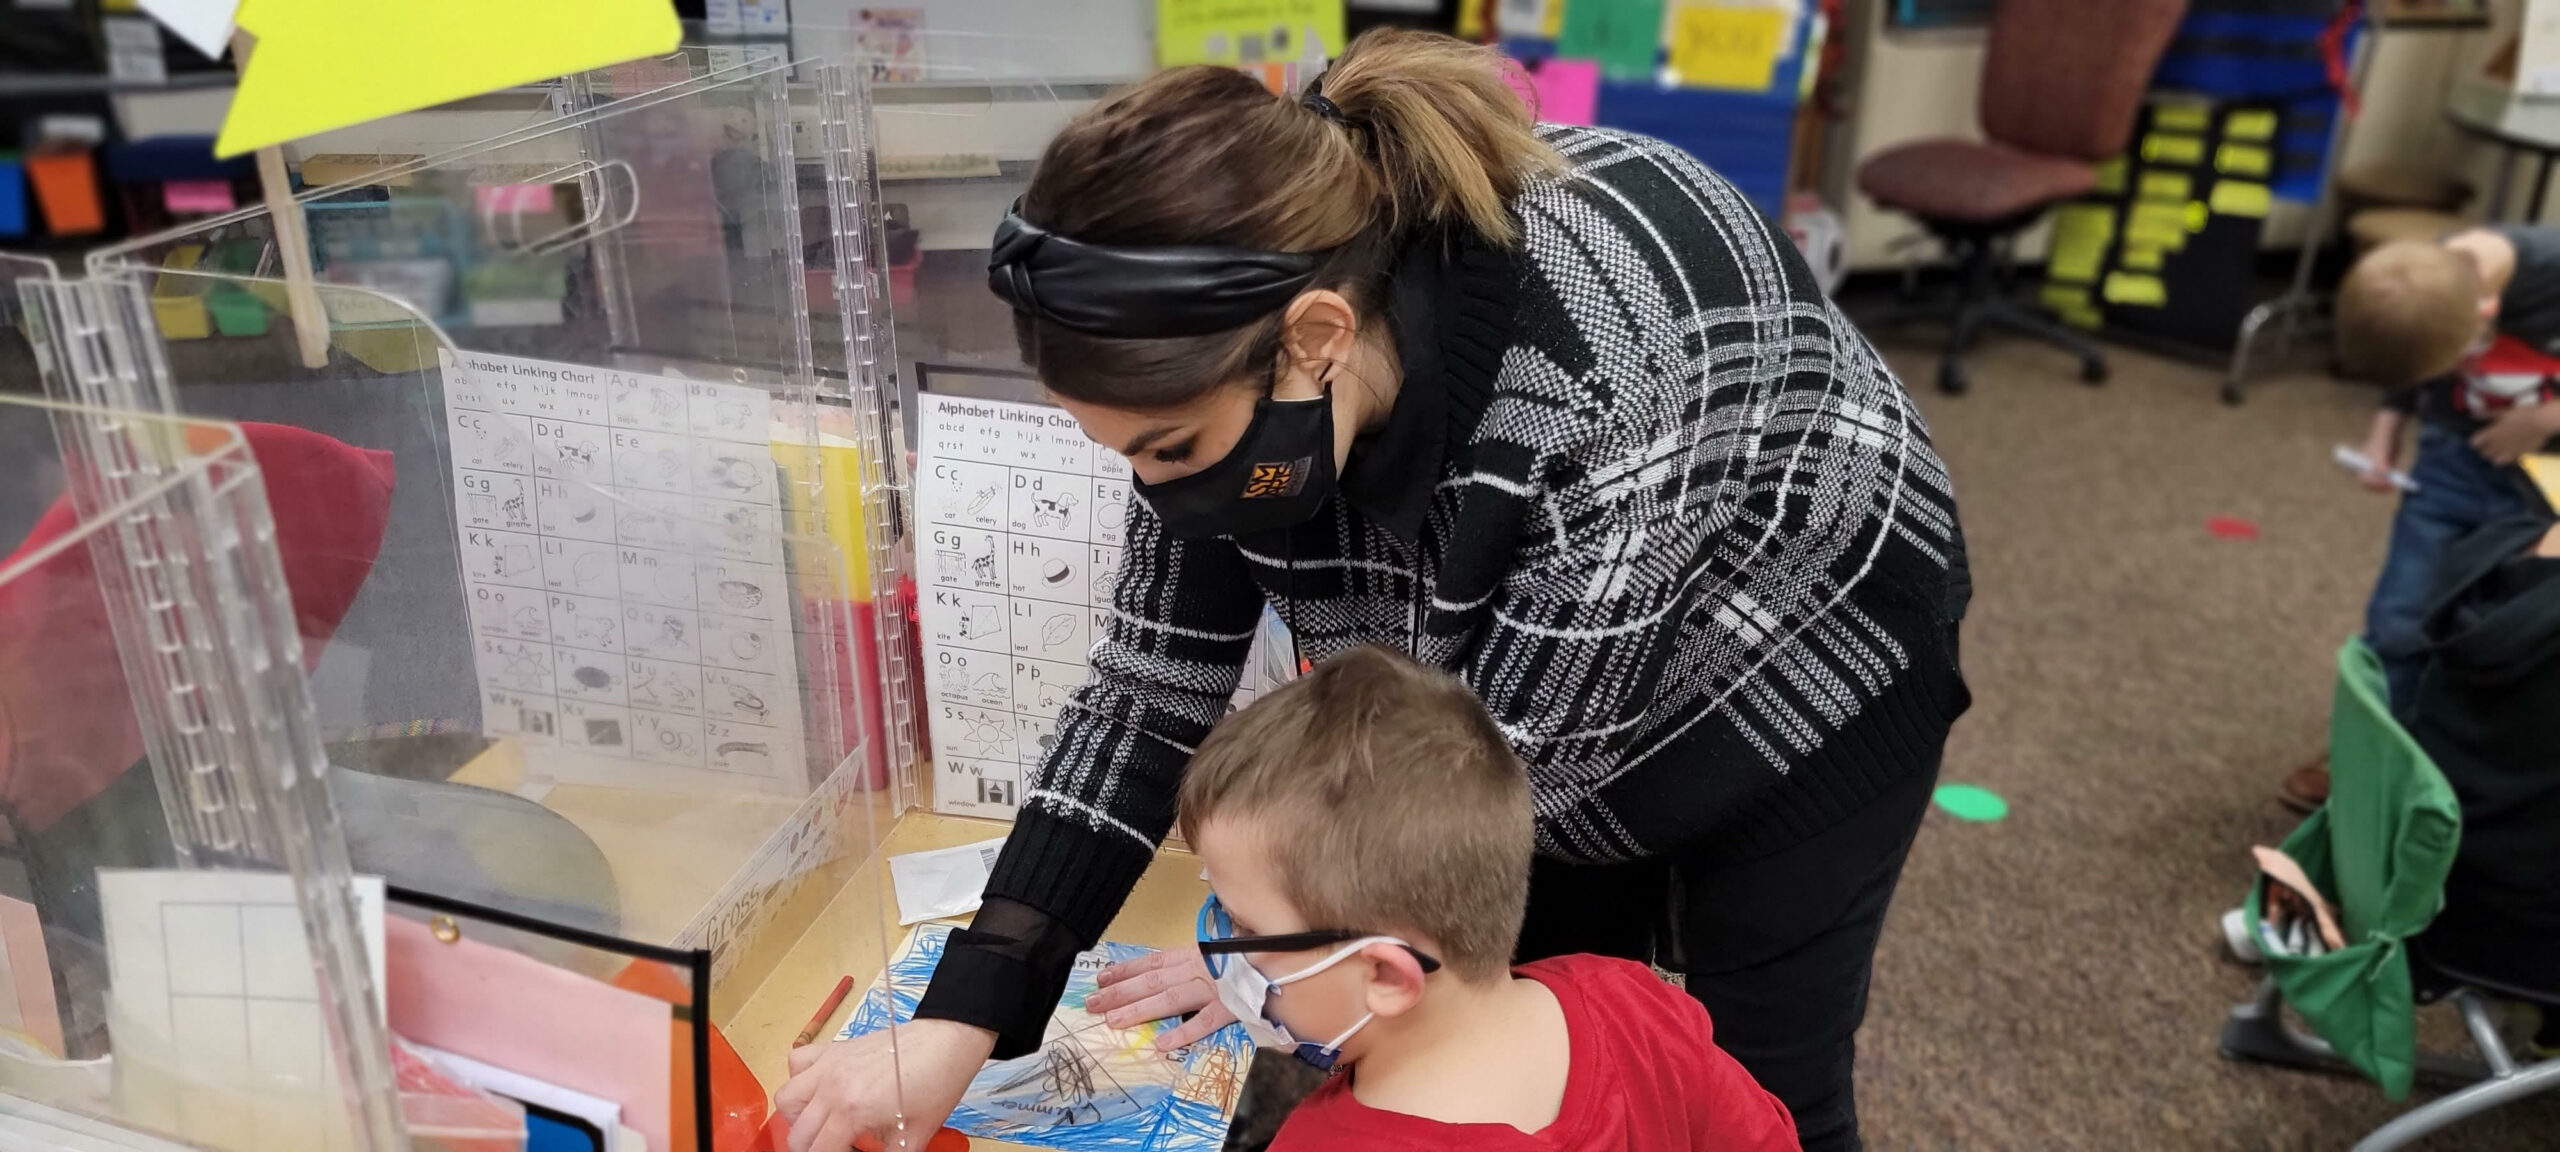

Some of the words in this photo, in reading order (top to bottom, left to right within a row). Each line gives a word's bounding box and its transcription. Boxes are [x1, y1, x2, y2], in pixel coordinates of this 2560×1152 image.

[512, 364, 556, 381] Linking
[561, 370, 595, 384] Chart
[937, 401, 994, 419] Alphabet
[1000, 408, 1044, 427] Linking
[1101, 464, 1124, 475] apple
[975, 515, 997, 526] celery
[1011, 520, 1027, 530] dog
[1101, 532, 1117, 542] egg
[940, 575, 957, 584] gate
[974, 579, 1001, 589] giraffe
[937, 632, 951, 641] kite
[981, 697, 1003, 706] ocean
